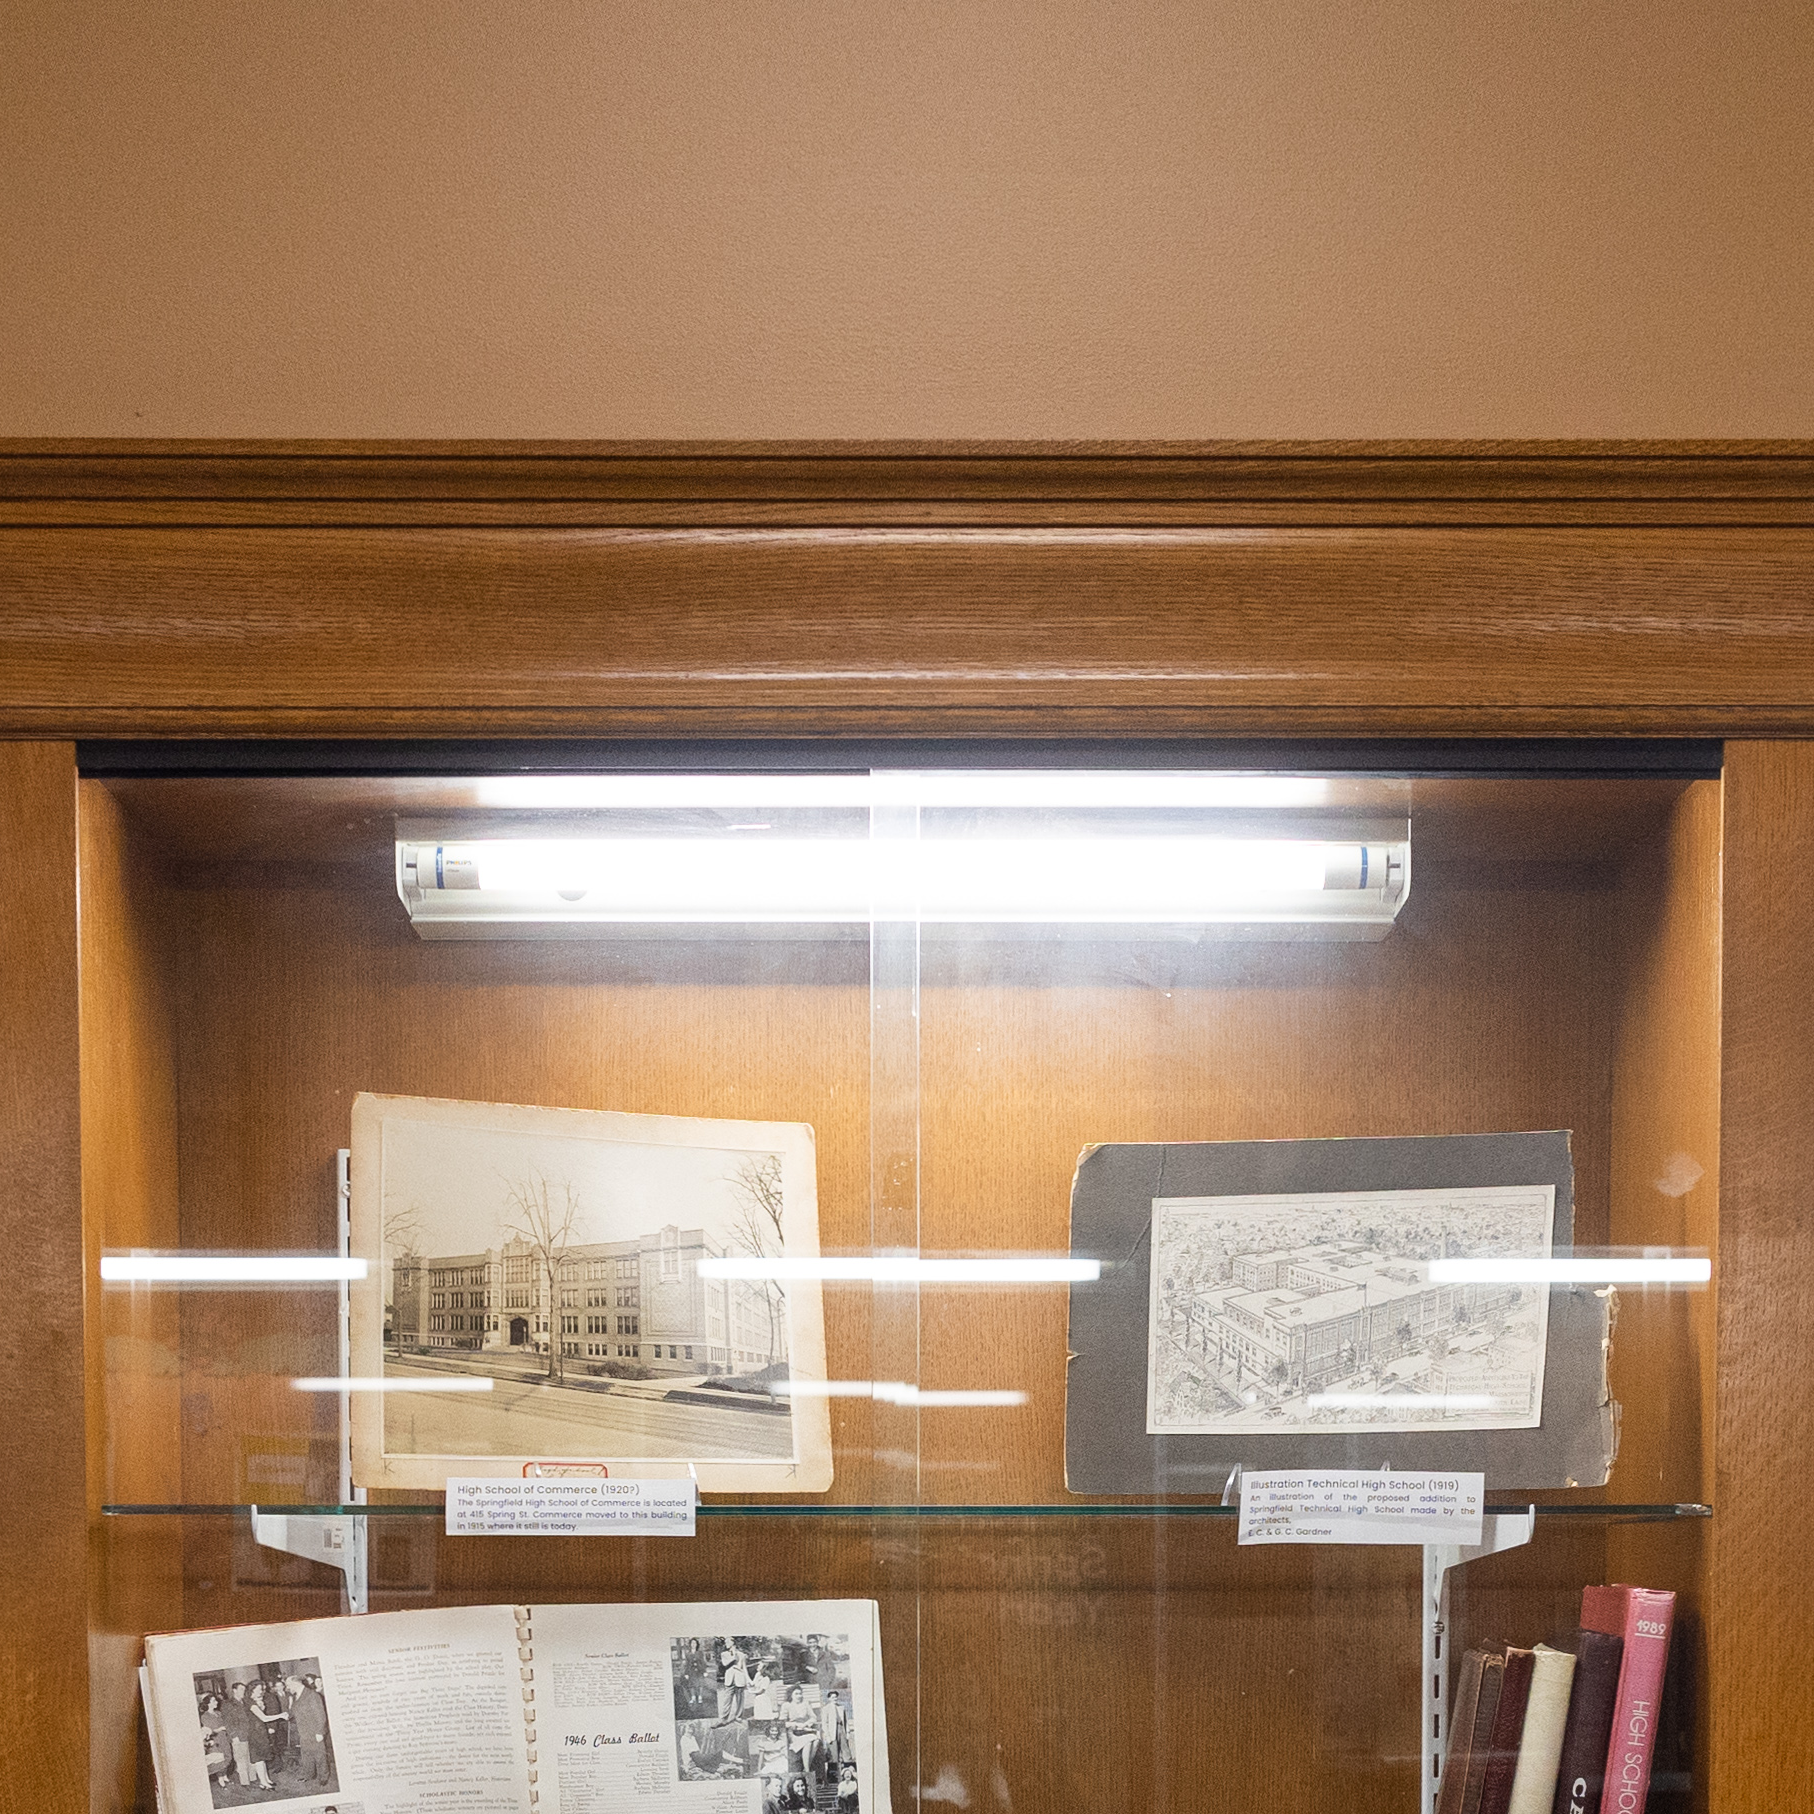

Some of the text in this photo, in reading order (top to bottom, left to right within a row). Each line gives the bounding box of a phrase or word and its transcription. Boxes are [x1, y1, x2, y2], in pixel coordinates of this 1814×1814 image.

[457, 1482, 640, 1497] High School of Commerce (1920?)
[1250, 1478, 1459, 1493] Illustration Technical High School (1919)
[1636, 1618, 1668, 1633] 1989
[1627, 1699, 1651, 1747] HIGH
[564, 1732, 660, 1748] 1946 Class Ballot
